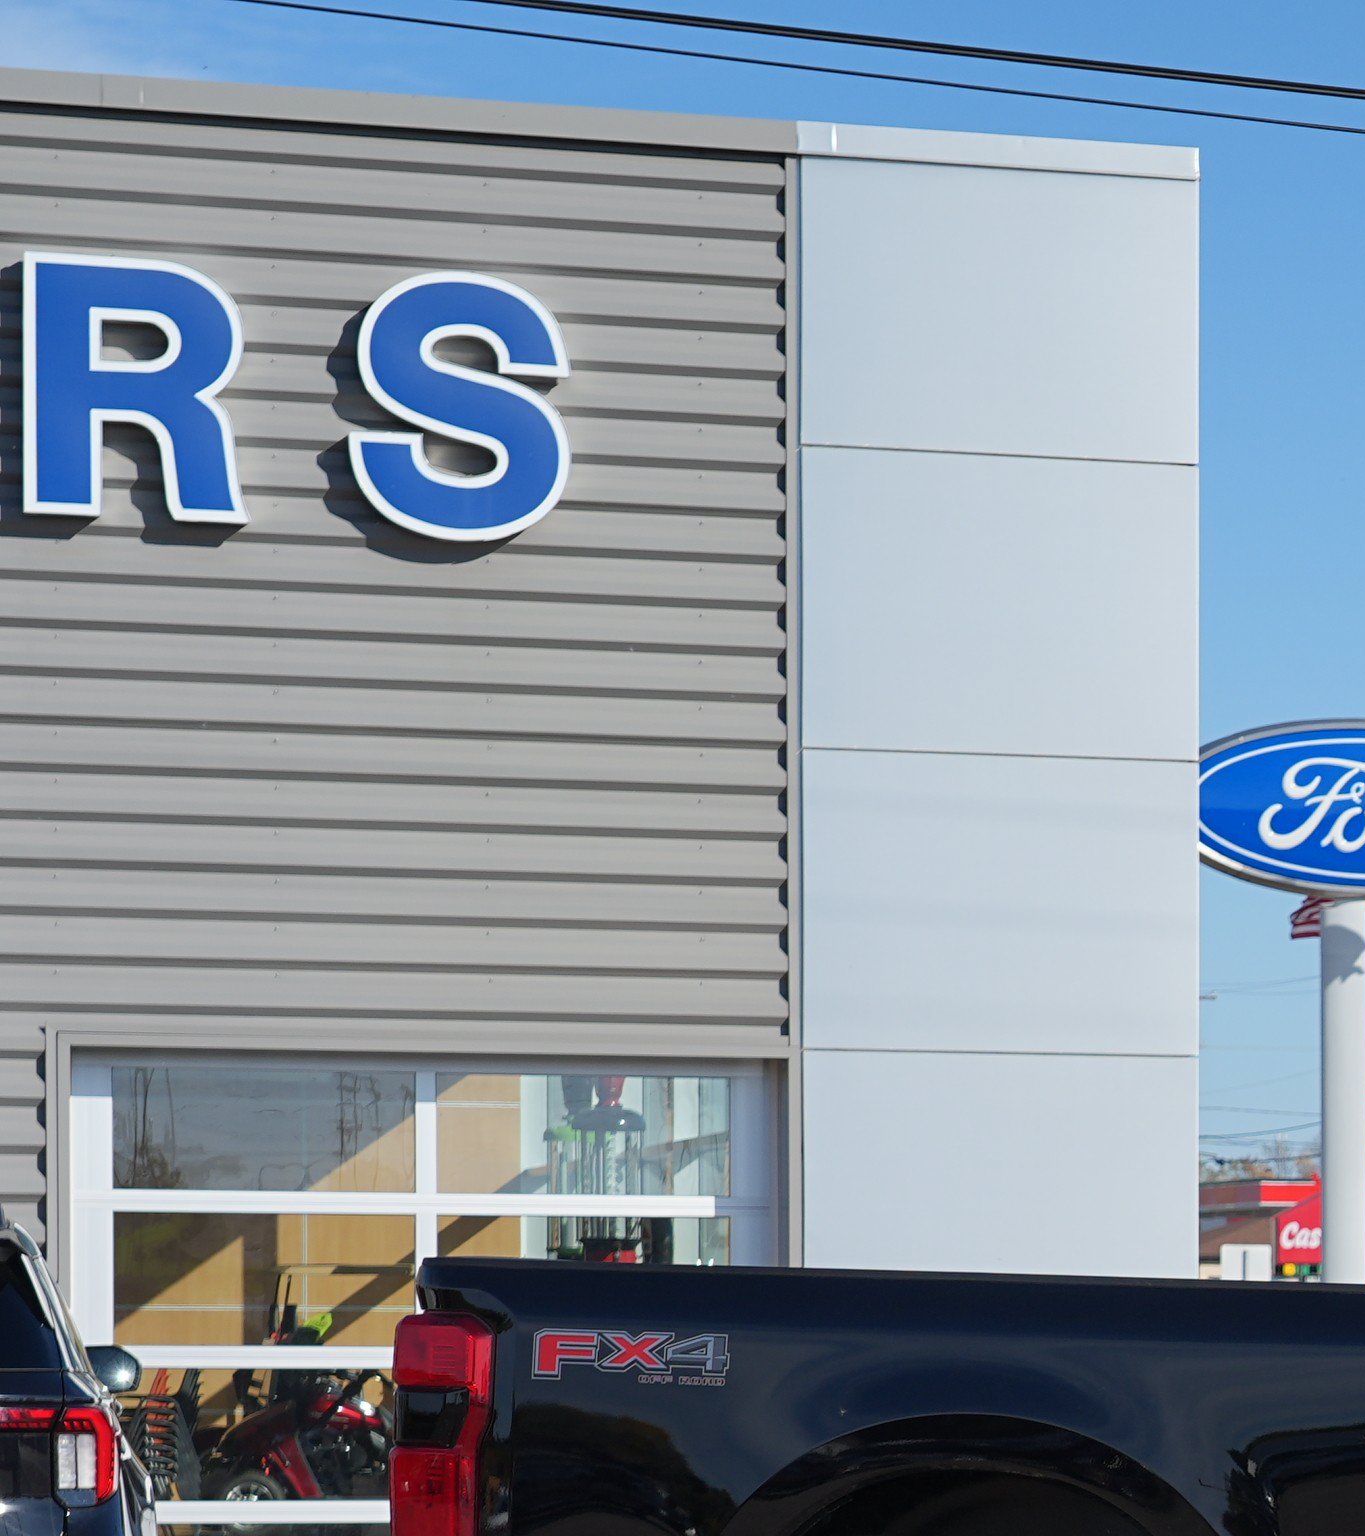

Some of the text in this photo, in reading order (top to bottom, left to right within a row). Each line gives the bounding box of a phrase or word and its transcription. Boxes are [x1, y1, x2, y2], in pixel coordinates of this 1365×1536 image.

[531, 1328, 731, 1380] FX4
[637, 1374, 727, 1387] OFF ROAD
